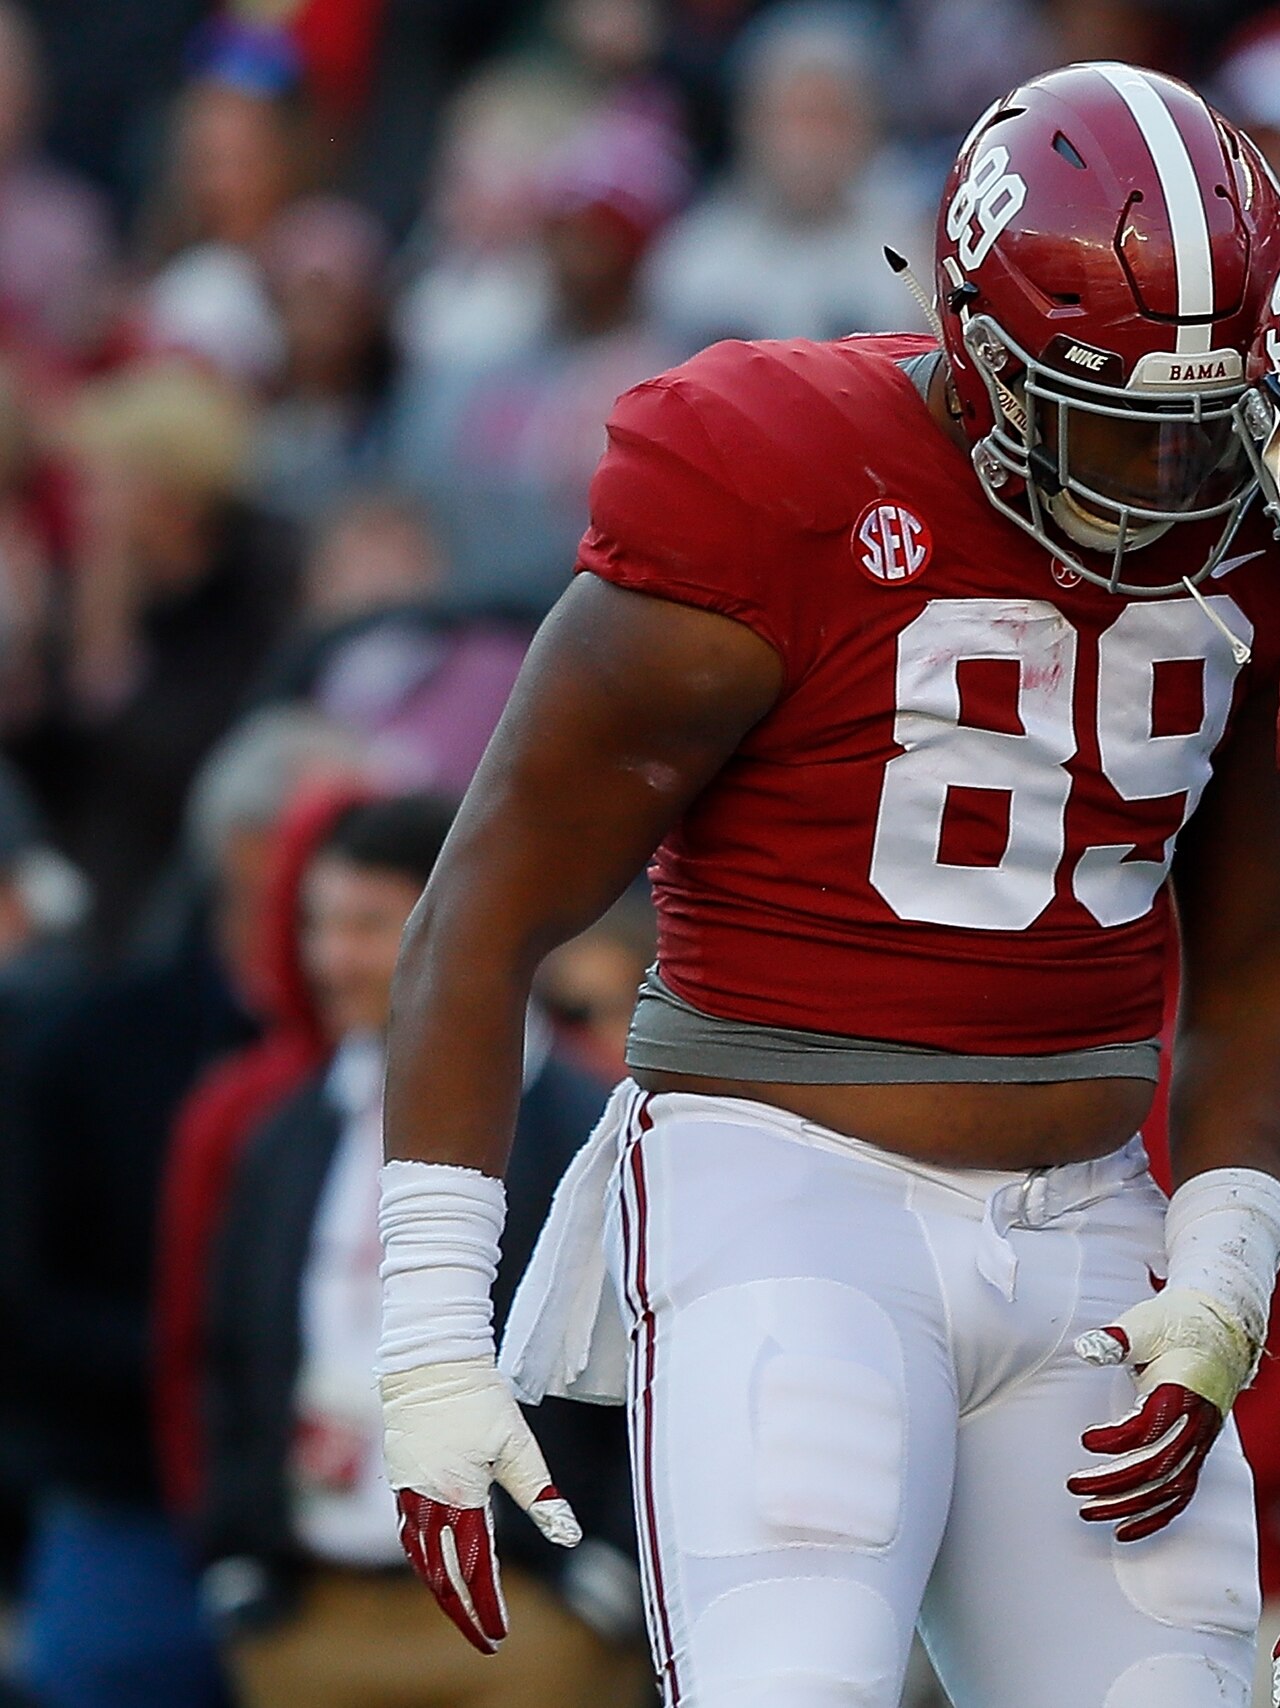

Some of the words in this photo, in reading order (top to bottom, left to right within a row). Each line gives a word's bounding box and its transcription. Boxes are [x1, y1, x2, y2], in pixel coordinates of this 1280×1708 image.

[946, 145, 1028, 272] 89
[1064, 346, 1108, 371] NIKE
[1170, 362, 1227, 381] BAMA
[859, 506, 926, 580] SEC
[868, 594, 1255, 931] 89
